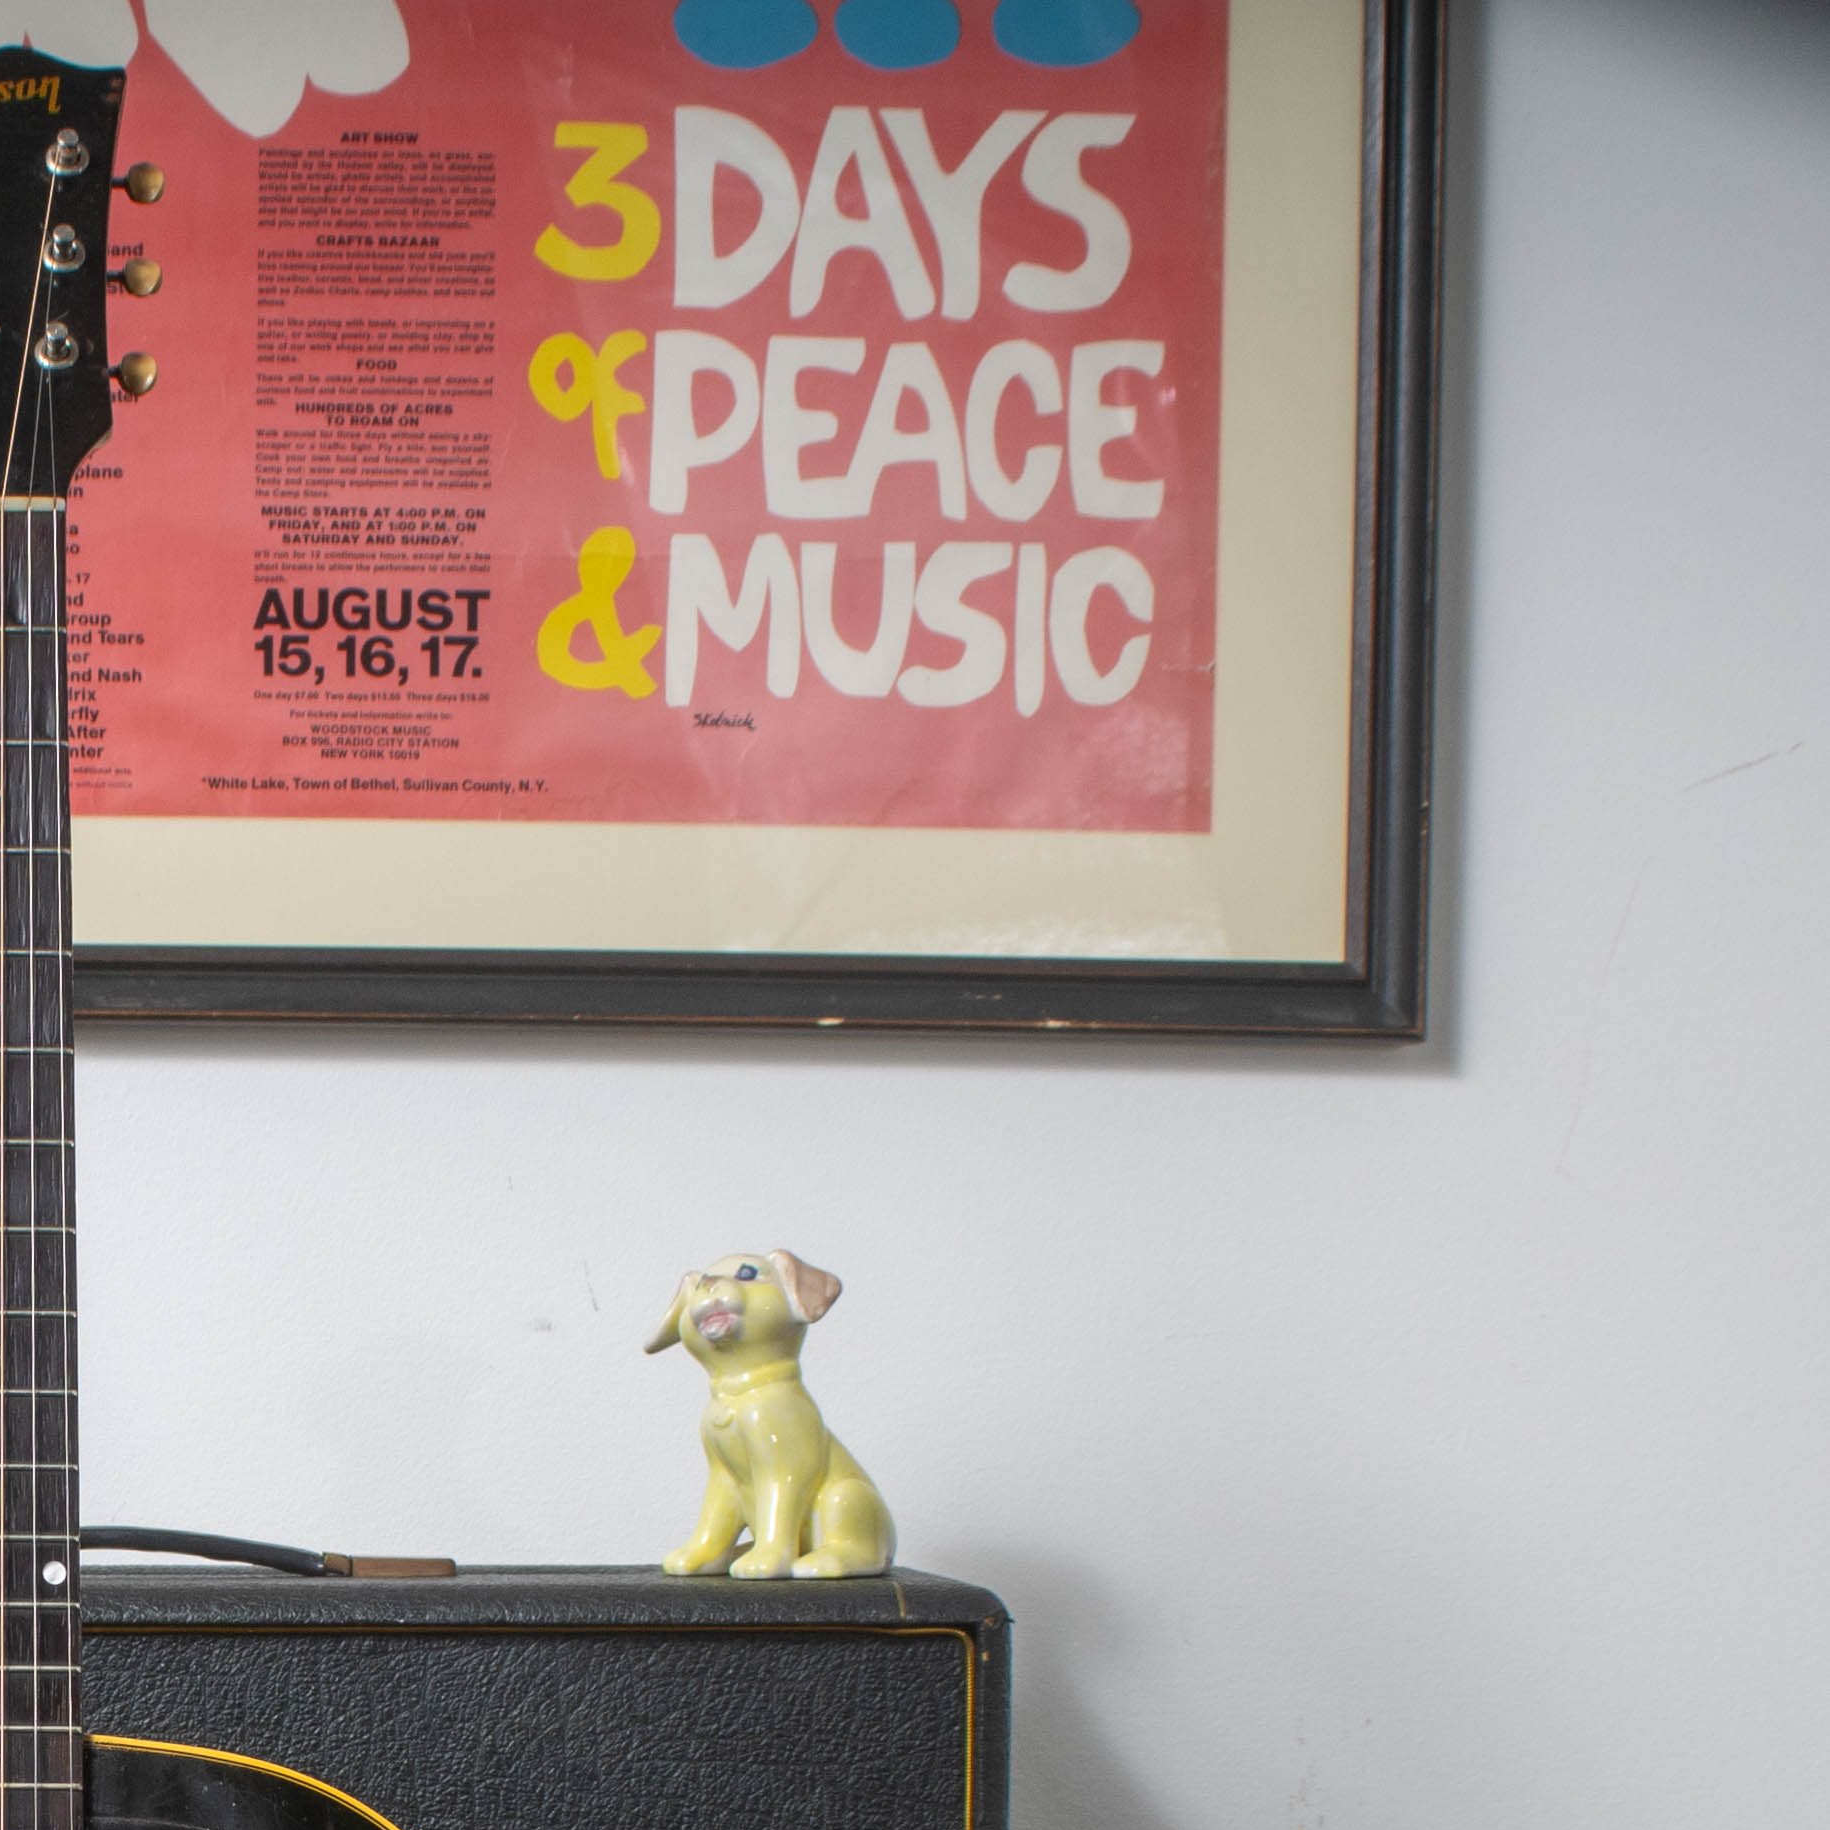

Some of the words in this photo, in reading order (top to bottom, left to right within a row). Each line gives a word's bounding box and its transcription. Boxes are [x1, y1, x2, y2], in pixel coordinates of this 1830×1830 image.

[340, 131, 369, 144] ART
[373, 131, 419, 144] SHOW
[534, 121, 661, 280] 3
[673, 106, 1137, 322] DAYS
[316, 234, 374, 246] CRAFTS
[378, 235, 440, 247] BAZAAR
[356, 359, 398, 371] FOOD
[294, 402, 375, 415] HUNDREDS
[379, 403, 399, 414] OF
[404, 403, 454, 415] ACRES
[326, 415, 345, 426] TO
[349, 415, 394, 427] ROAM
[398, 416, 420, 427] ON
[528, 330, 648, 480] of
[649, 330, 1166, 522] PEACE
[261, 505, 308, 517] MUSIC
[312, 505, 368, 517] STARTS
[373, 506, 392, 517] AT
[464, 508, 486, 519] ON
[281, 533, 360, 545] SATURDAY
[365, 533, 396, 545] AND
[400, 534, 464, 546] SUNDAY.
[253, 587, 491, 632] AUGUST
[536, 526, 662, 699] &
[665, 533, 1154, 717] MUSIC
[254, 634, 326, 685] 15,
[336, 634, 410, 685] 16,
[420, 635, 483, 678] 17.
[310, 724, 390, 736] WOODSTOCK
[392, 725, 432, 736] MUSIC
[320, 748, 348, 759] NEW
[352, 748, 386, 760] YORK
[251, 777, 289, 792] Lake,
[292, 778, 330, 791] Town
[333, 777, 348, 790] of
[350, 777, 400, 792] Bethel,
[402, 777, 459, 792] Sullivan
[461, 778, 516, 795] County,
